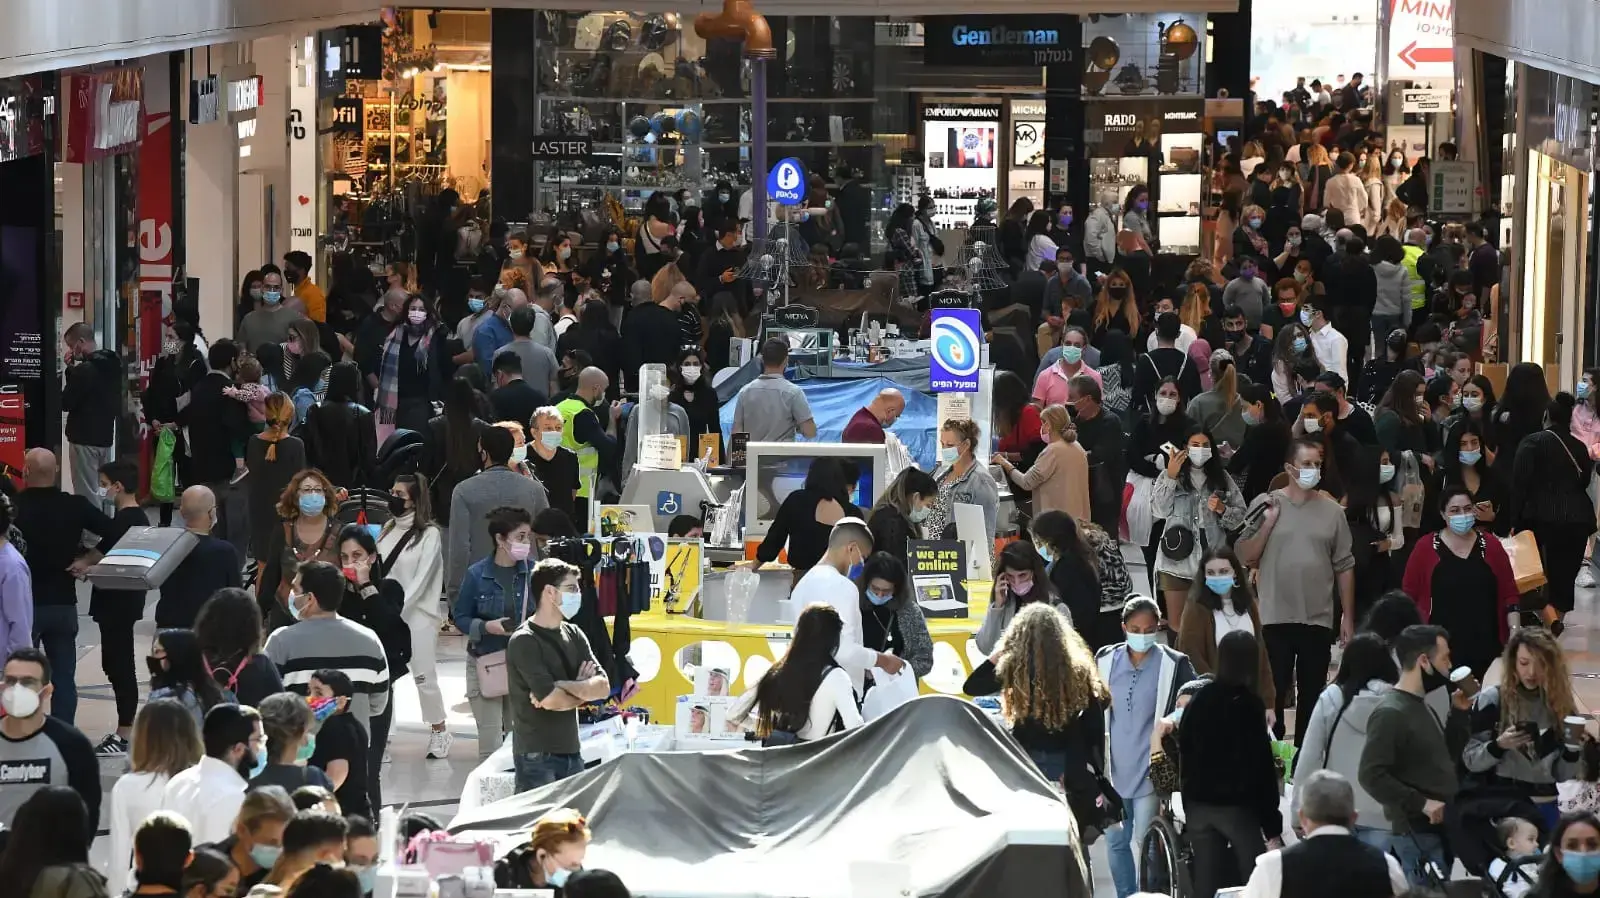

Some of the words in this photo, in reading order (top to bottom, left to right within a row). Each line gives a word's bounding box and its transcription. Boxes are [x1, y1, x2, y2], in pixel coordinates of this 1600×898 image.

[952, 25, 1058, 45] Gentleman
[925, 107, 959, 117] EMPORIO
[969, 107, 999, 117] ARMANI
[1104, 114, 1136, 127] RADO
[532, 141, 588, 155] LASTER
[932, 380, 953, 388] הפיס
[953, 380, 977, 389] מפעל
[916, 551, 934, 559] we
[937, 551, 958, 559] are
[917, 560, 958, 571] online
